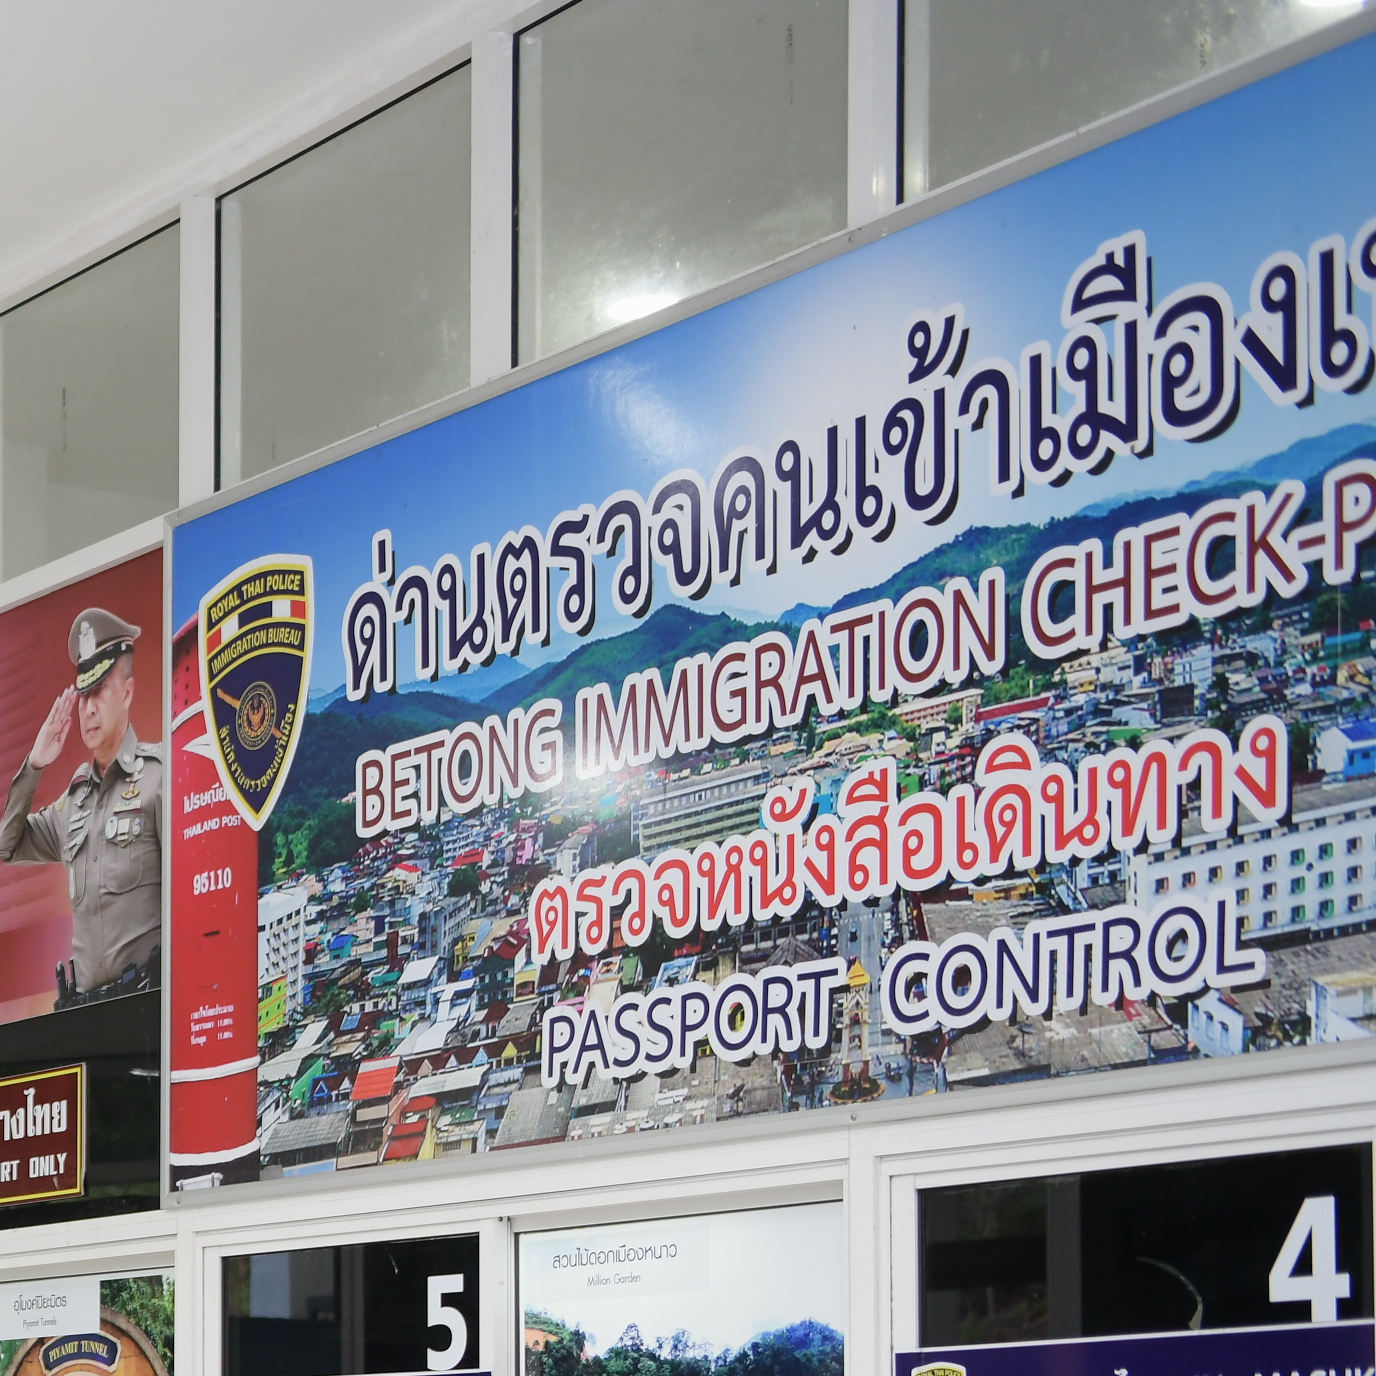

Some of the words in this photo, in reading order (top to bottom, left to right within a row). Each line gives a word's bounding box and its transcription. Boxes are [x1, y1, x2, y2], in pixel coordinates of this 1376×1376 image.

[347, 236, 1376, 691] ด่านตรวจคนเข้าเมืองเ
[209, 597, 240, 624] ROYAL
[241, 577, 265, 601] THAI
[266, 573, 301, 592] POLICE
[211, 631, 268, 675] IMMIGRATION
[268, 627, 301, 646] BUREAU
[361, 709, 557, 829] BETONG
[581, 578, 997, 771] IMMIGRATION
[183, 817, 220, 840] THAILAND
[222, 815, 242, 827] POST
[535, 726, 1278, 953] ตรวจหนังสือเดินทาง
[193, 867, 232, 896] 95110
[547, 966, 839, 1079] PASSPORT
[888, 899, 1257, 1025] CONTROL
[29, 1152, 68, 1179] ONLY
[552, 1243, 678, 1269] สวนไม้ดอกเมืองหนาว
[587, 1274, 611, 1287] Million
[613, 1271, 641, 1285] Garden
[1268, 1195, 1351, 1324] 4
[426, 1273, 469, 1371] 5
[48, 1340, 79, 1363] PIYAMIT
[80, 1340, 109, 1358] TUNNEL
